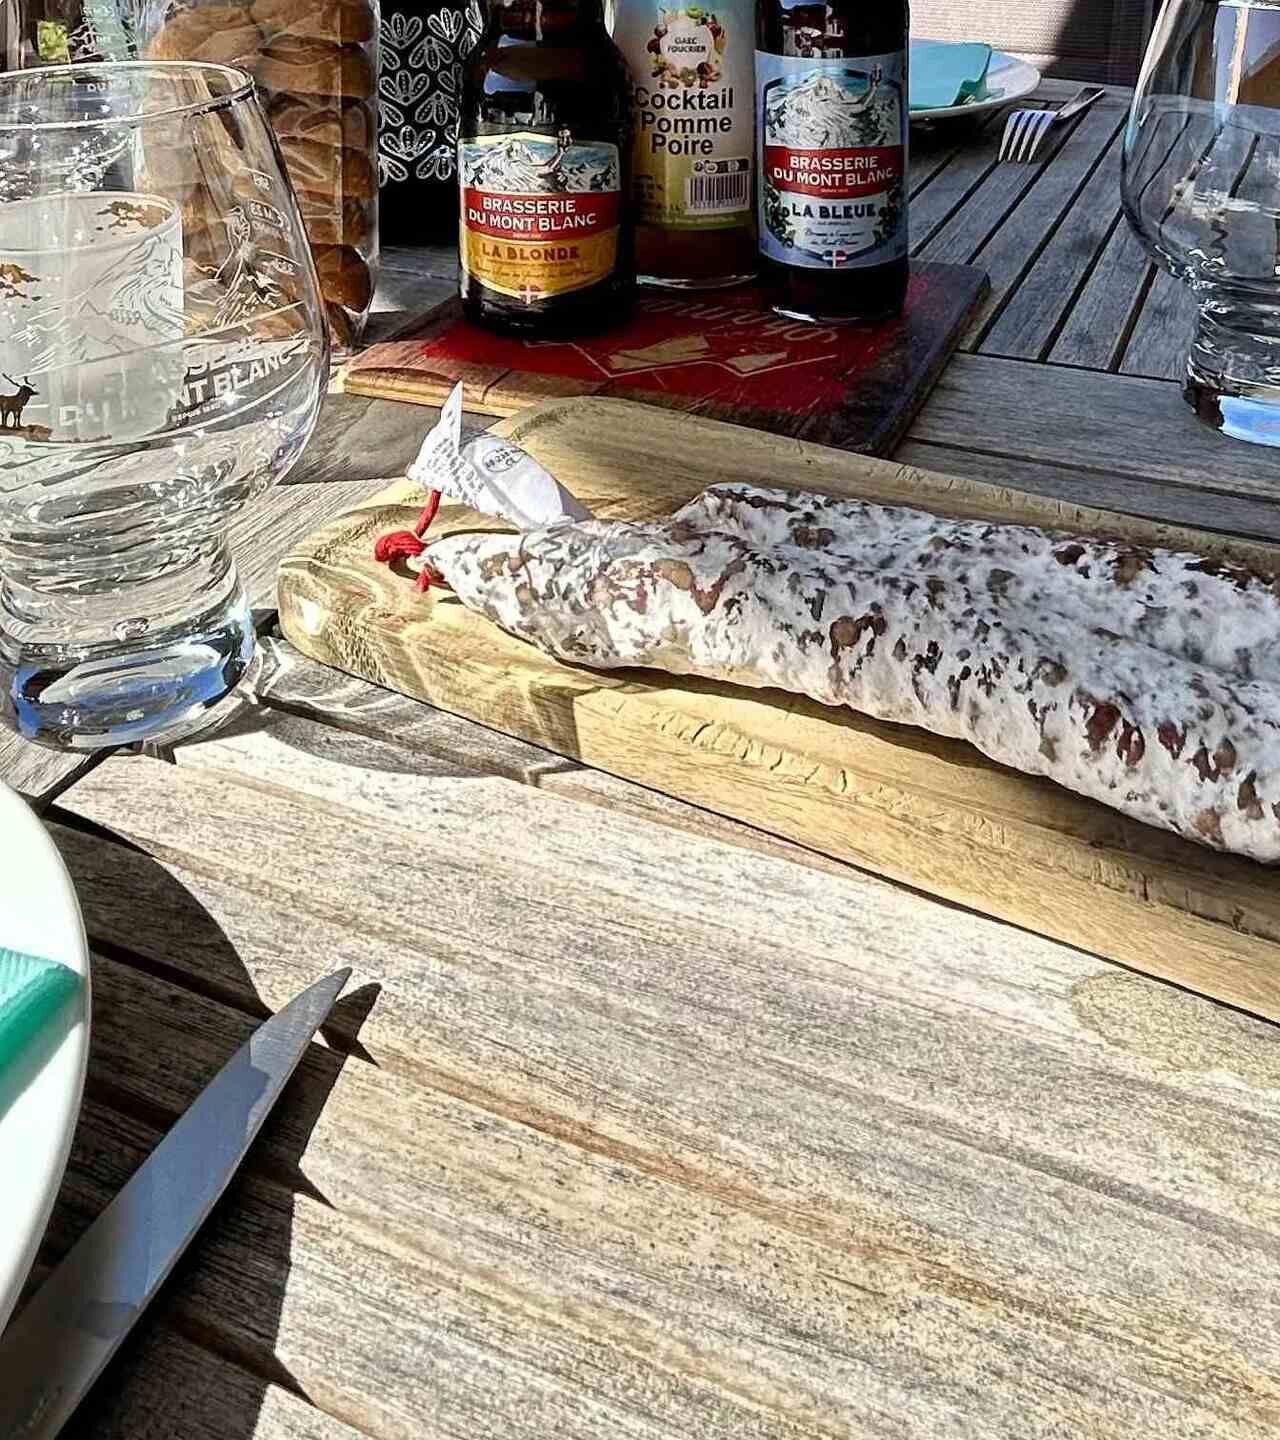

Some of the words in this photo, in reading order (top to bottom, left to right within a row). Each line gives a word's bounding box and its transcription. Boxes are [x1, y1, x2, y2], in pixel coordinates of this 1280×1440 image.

[634, 87, 734, 110] Cocktail
[641, 110, 732, 134] Pomme
[651, 133, 713, 155] Poire
[790, 156, 879, 170] BRASSERIE
[773, 168, 794, 182] DU
[796, 172, 843, 186] MONT
[846, 168, 894, 186] BLANC
[483, 197, 576, 214] BRASSERIE
[792, 203, 813, 218] LA
[819, 204, 876, 219] BLEUE
[469, 208, 487, 224] DU
[490, 214, 536, 232] MONT
[539, 212, 597, 232] BLANC
[481, 243, 502, 258] LA
[507, 246, 580, 261] BLONDE
